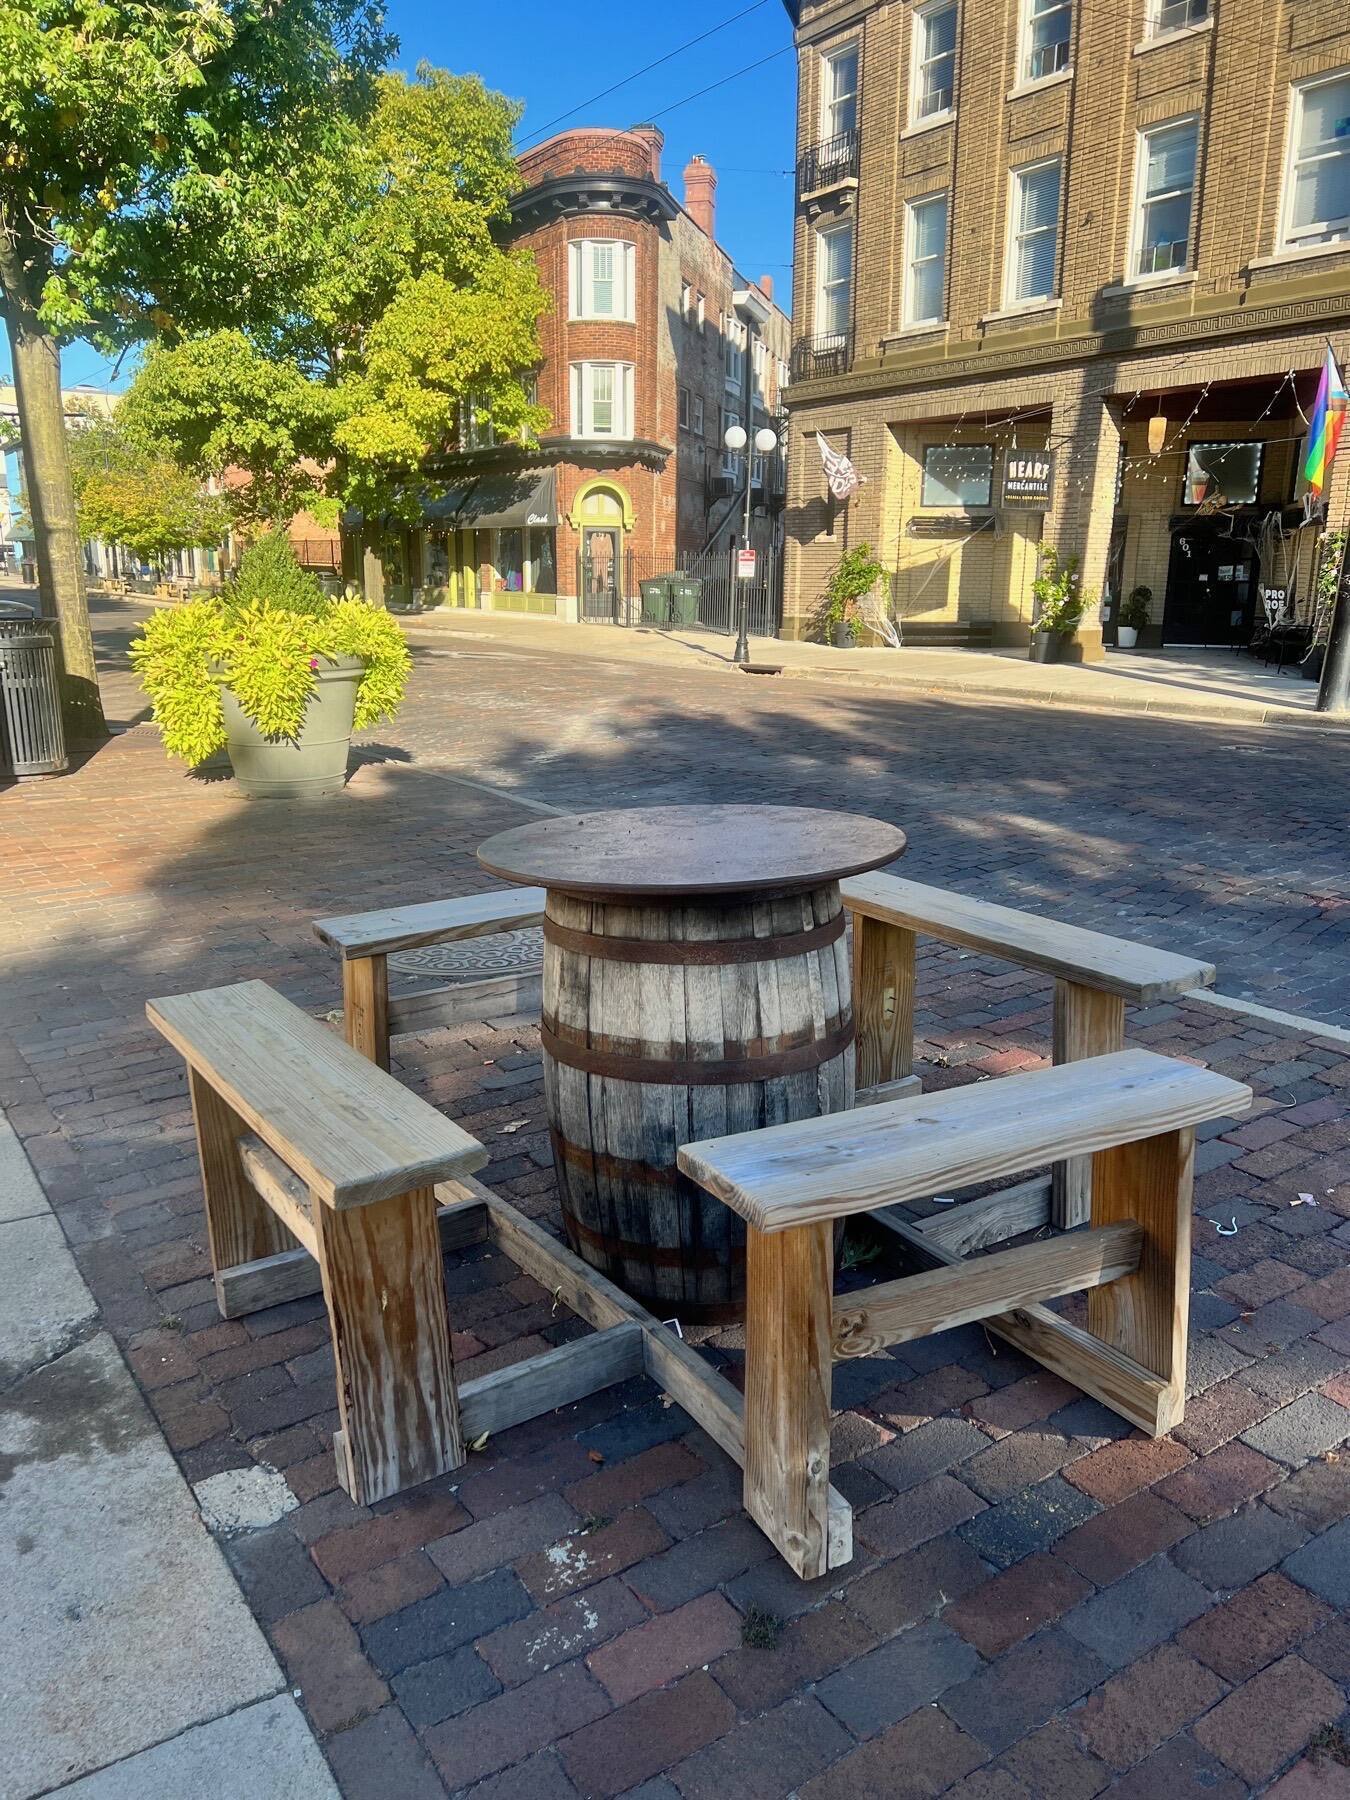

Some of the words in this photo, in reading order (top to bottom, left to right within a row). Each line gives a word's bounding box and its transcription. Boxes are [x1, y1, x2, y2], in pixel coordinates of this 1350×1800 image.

[1009, 461, 1050, 480] HEART
[1007, 481, 1048, 491] MERCANTILE
[1265, 589, 1285, 600] PRO
